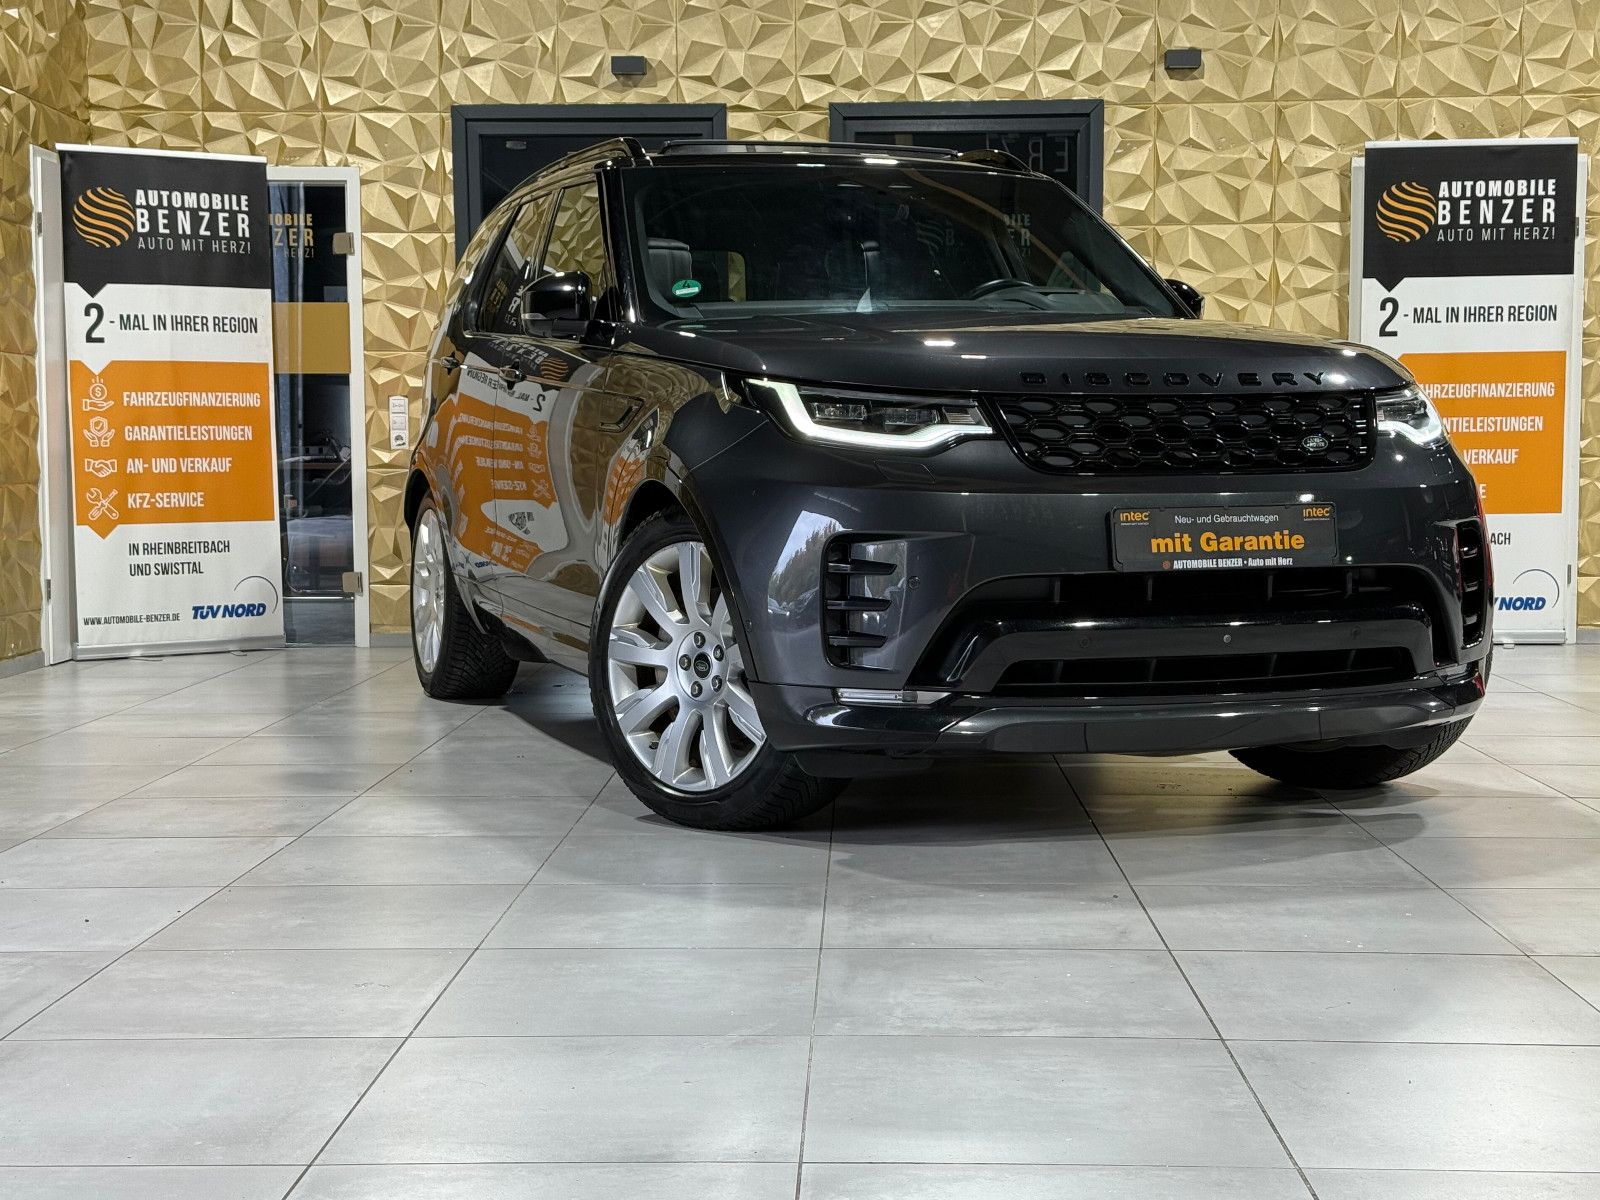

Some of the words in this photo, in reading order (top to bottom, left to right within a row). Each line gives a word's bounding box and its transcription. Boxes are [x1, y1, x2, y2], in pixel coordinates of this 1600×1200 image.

[1438, 179, 1557, 198] AUTOMOBILE
[135, 189, 249, 211] AUTOMOBILE
[1437, 198, 1556, 225] BENZER
[136, 208, 250, 238] BENZER
[1437, 229, 1474, 242] AUTO
[1482, 228, 1504, 241] MIT
[1514, 226, 1556, 240] HERZ!
[138, 236, 174, 251] AUTO
[181, 238, 204, 252] MIT
[212, 239, 251, 254] HERZ!
[83, 302, 105, 344] 2
[119, 314, 150, 331] MAL
[153, 315, 166, 332] IN
[170, 315, 209, 332] IHRER
[213, 316, 258, 334] REGION
[1378, 296, 1400, 338] 2
[1413, 306, 1442, 324] MAL
[1446, 306, 1460, 323] IN
[1464, 305, 1504, 323] IHRER
[1508, 305, 1558, 323] REGION
[1020, 372, 1325, 387] DISCOVERY
[122, 392, 261, 408] FAHRZEUGFINANZIERUNG
[124, 425, 253, 442] GARANTIELEISTUNGEN
[1463, 448, 1519, 465] VERKAUF
[126, 458, 149, 474] AN-
[152, 458, 177, 473] UND
[179, 457, 233, 473] VERKAUF
[127, 492, 205, 509] KFZ-SERVICE
[1120, 511, 1149, 521] intec
[1174, 515, 1194, 524] Neu-
[1196, 515, 1211, 523] und
[1213, 514, 1279, 523] Gebrauchtwagen
[1303, 507, 1330, 517] intec
[129, 543, 139, 557] IN
[142, 540, 231, 556] RHEINBREITBACH
[1150, 532, 1192, 553] mit
[1199, 530, 1305, 552] Garantie
[129, 562, 152, 577] UND
[154, 561, 204, 577] SWISTTAL
[1173, 559, 1217, 569] AUTOMOBILE
[1219, 558, 1243, 568] BENZER
[1248, 558, 1264, 567] Auto
[1265, 557, 1277, 566] mit
[1277, 556, 1293, 566] Herz
[191, 605, 224, 620] TÜV
[221, 603, 267, 618] NORD
[1498, 596, 1546, 611] NORD
[83, 612, 181, 626] WWW.AUTOMOBILE-BENZER.DE
